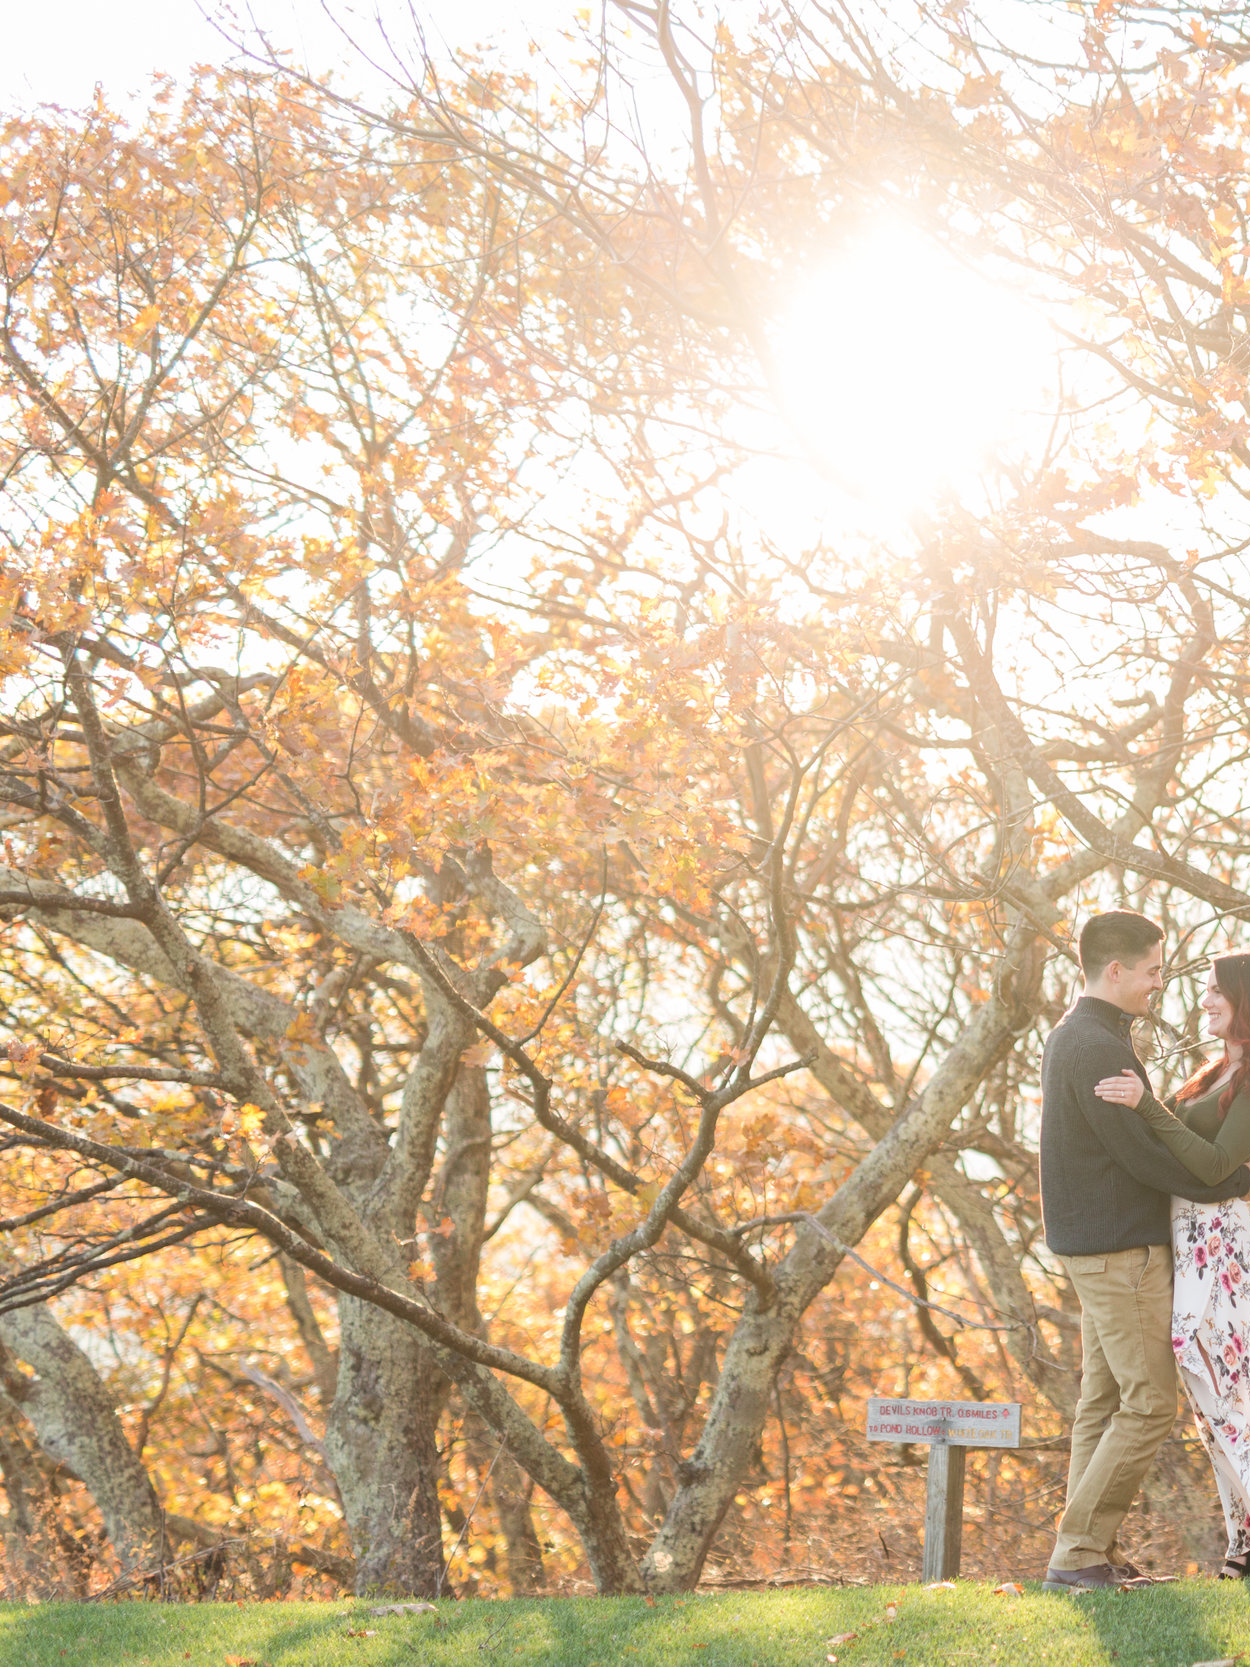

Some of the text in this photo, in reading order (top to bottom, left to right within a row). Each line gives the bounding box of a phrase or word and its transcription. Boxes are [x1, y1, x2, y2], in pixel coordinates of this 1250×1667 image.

[880, 1406, 911, 1416] DEVILS
[913, 1407, 938, 1416] KNOB
[880, 1424, 902, 1434] POND
[906, 1424, 941, 1436] HOLLOW
